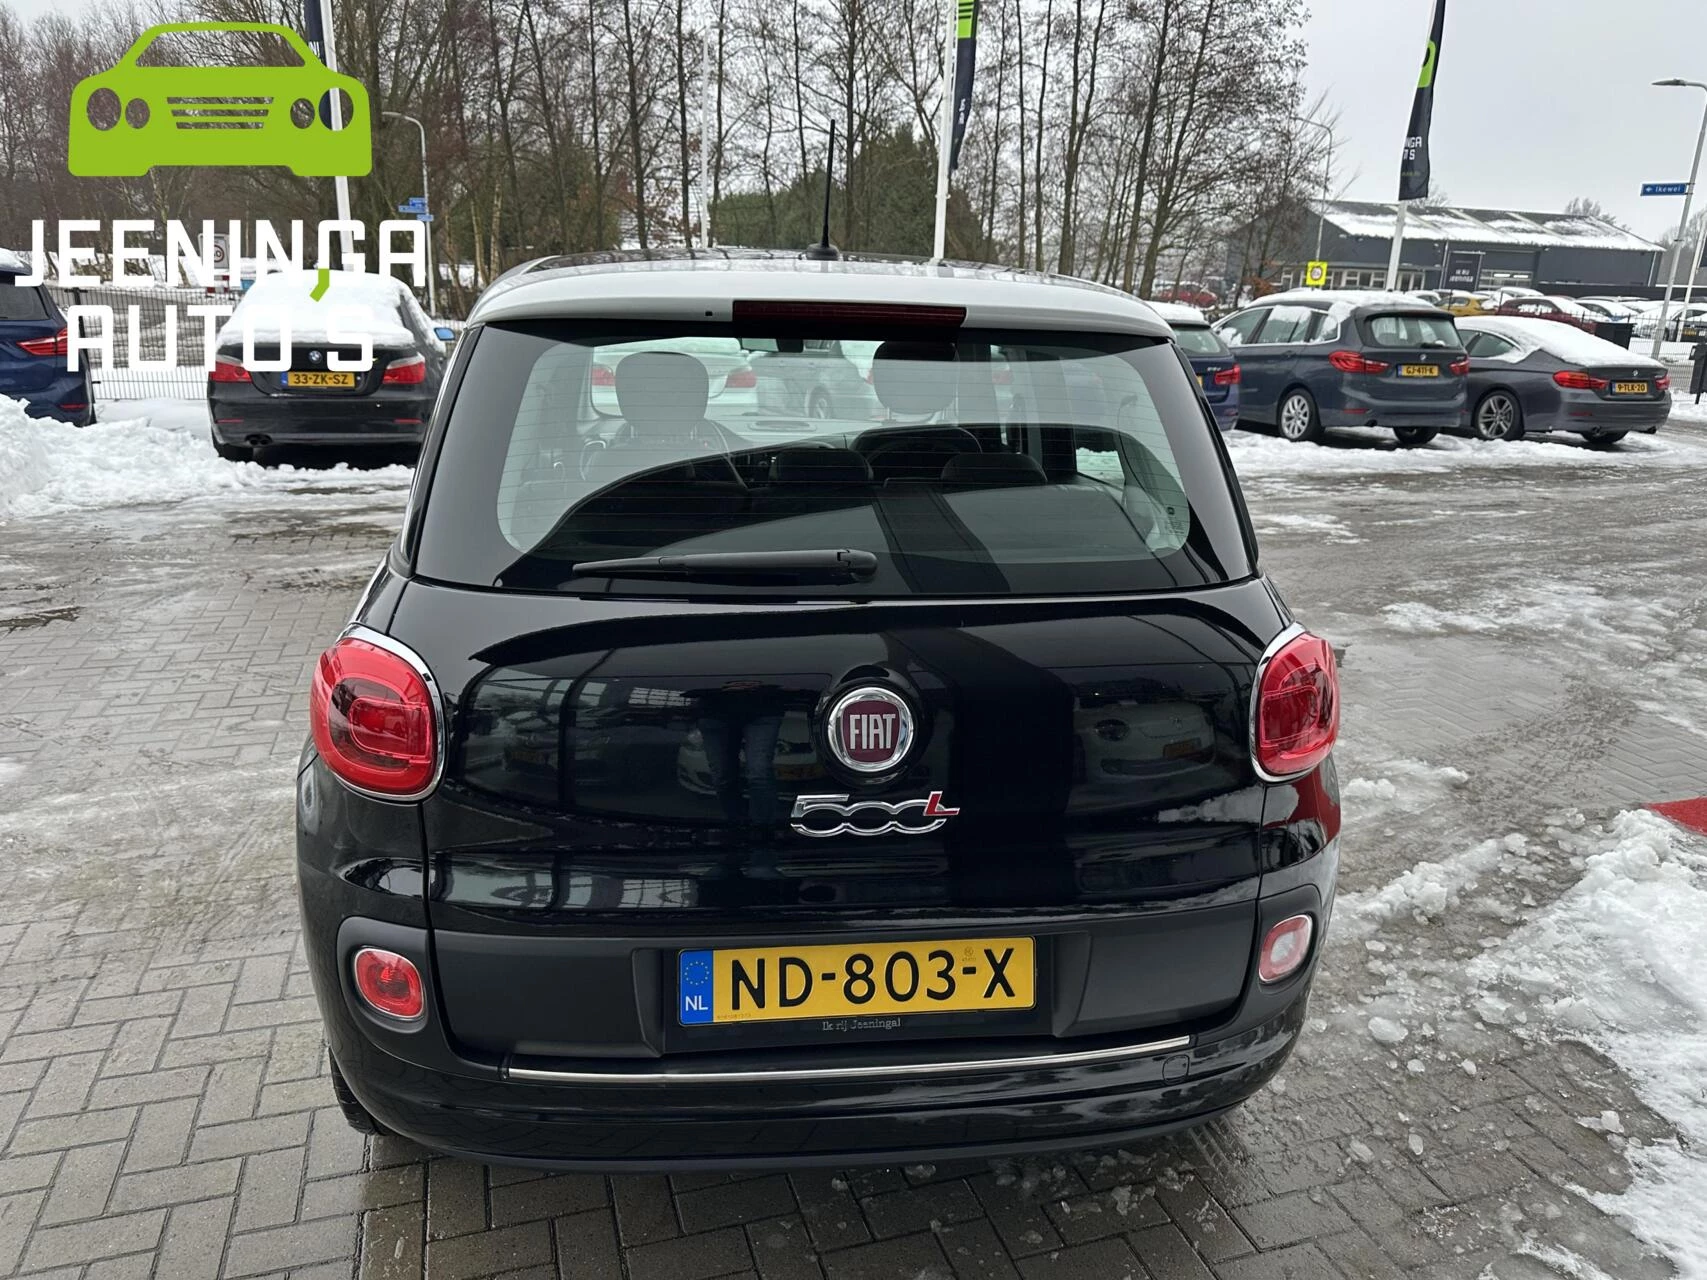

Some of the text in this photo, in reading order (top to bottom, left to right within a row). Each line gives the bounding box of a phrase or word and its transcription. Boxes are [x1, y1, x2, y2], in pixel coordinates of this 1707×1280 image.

[293, 373, 349, 385] 33-ZK-SZ
[849, 713, 896, 750] FIAT
[730, 947, 1016, 1011] ND-803-X
[684, 995, 709, 1011] NL
